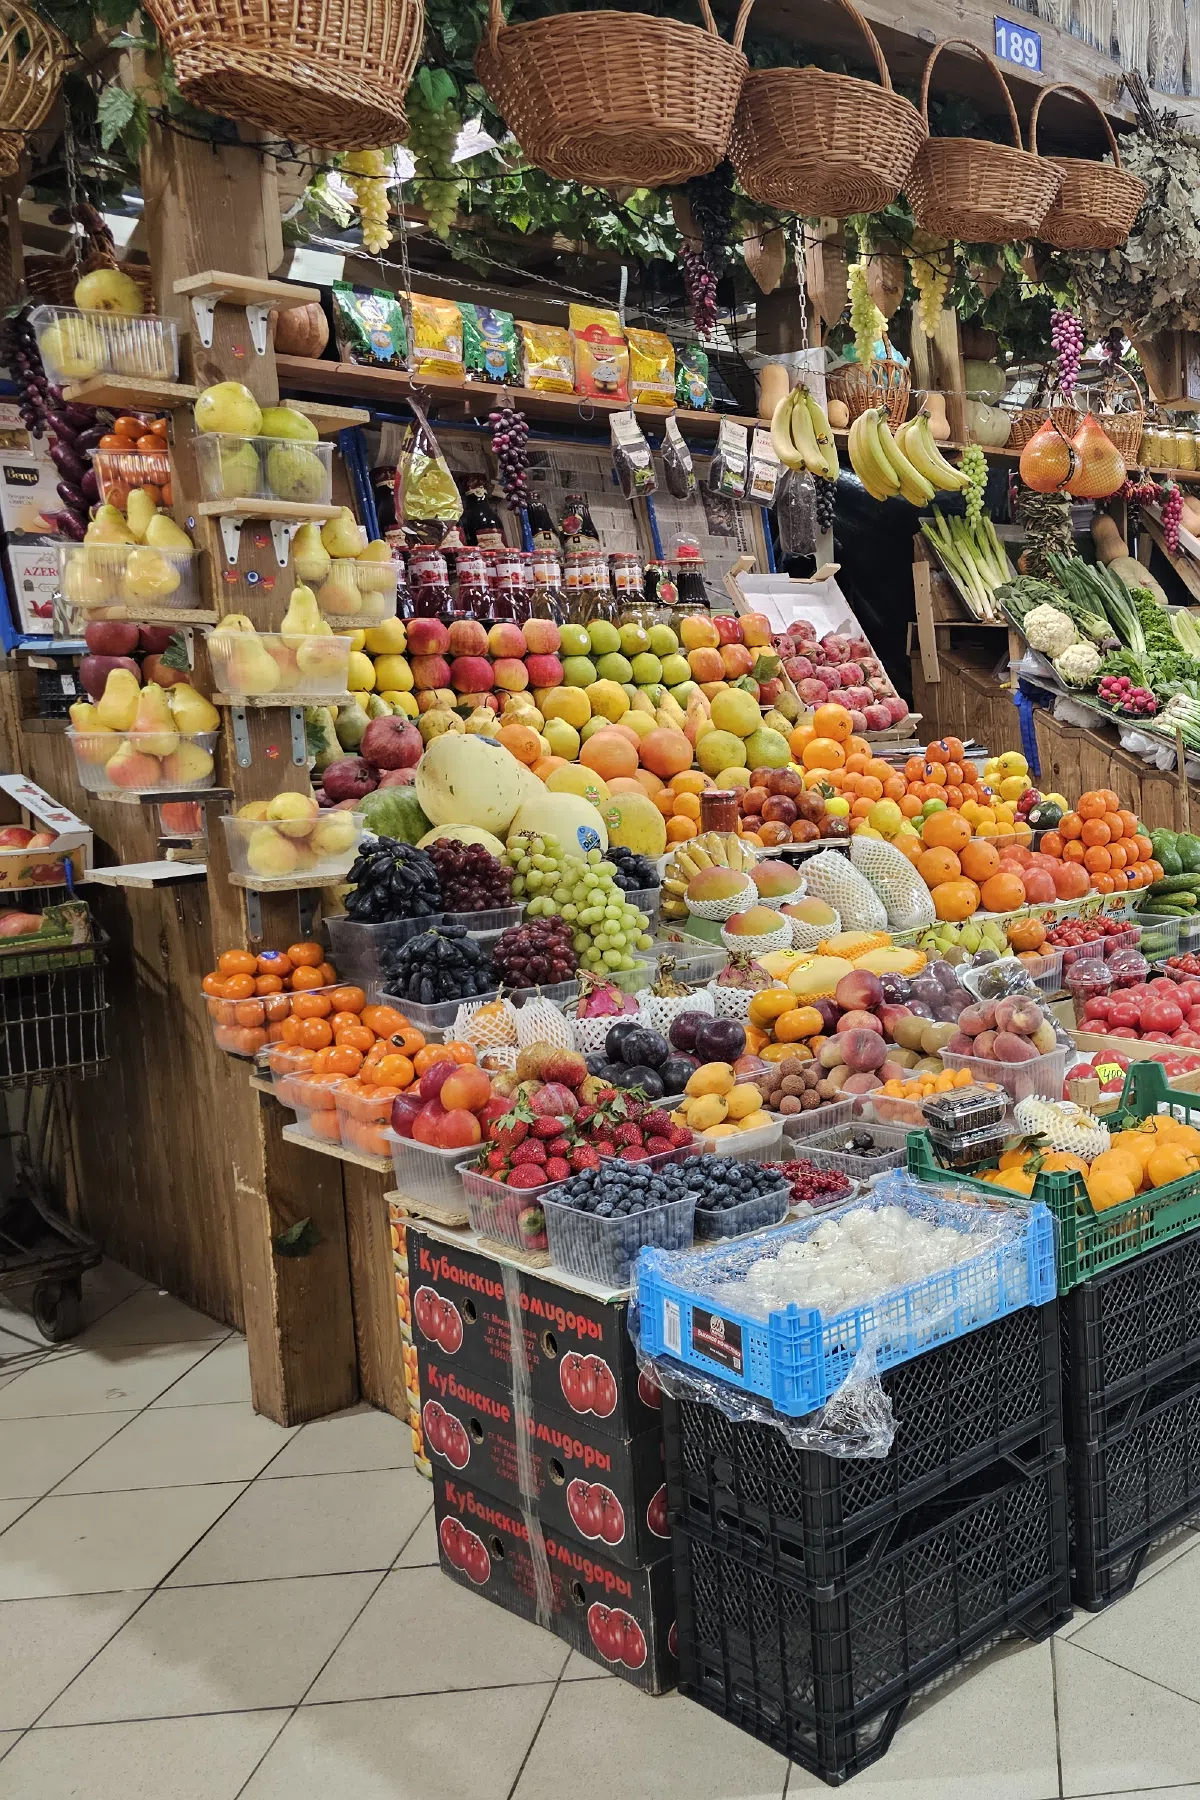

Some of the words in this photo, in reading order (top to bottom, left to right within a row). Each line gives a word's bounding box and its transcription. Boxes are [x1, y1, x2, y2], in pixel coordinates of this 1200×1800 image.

[996, 26, 1037, 67] 189
[24, 567, 59, 577] AZER
[1103, 1068, 1123, 1081] 400
[419, 1247, 505, 1300] Кубанские
[428, 1363, 511, 1423] Кубанские
[444, 1480, 530, 1543] Кубанские
